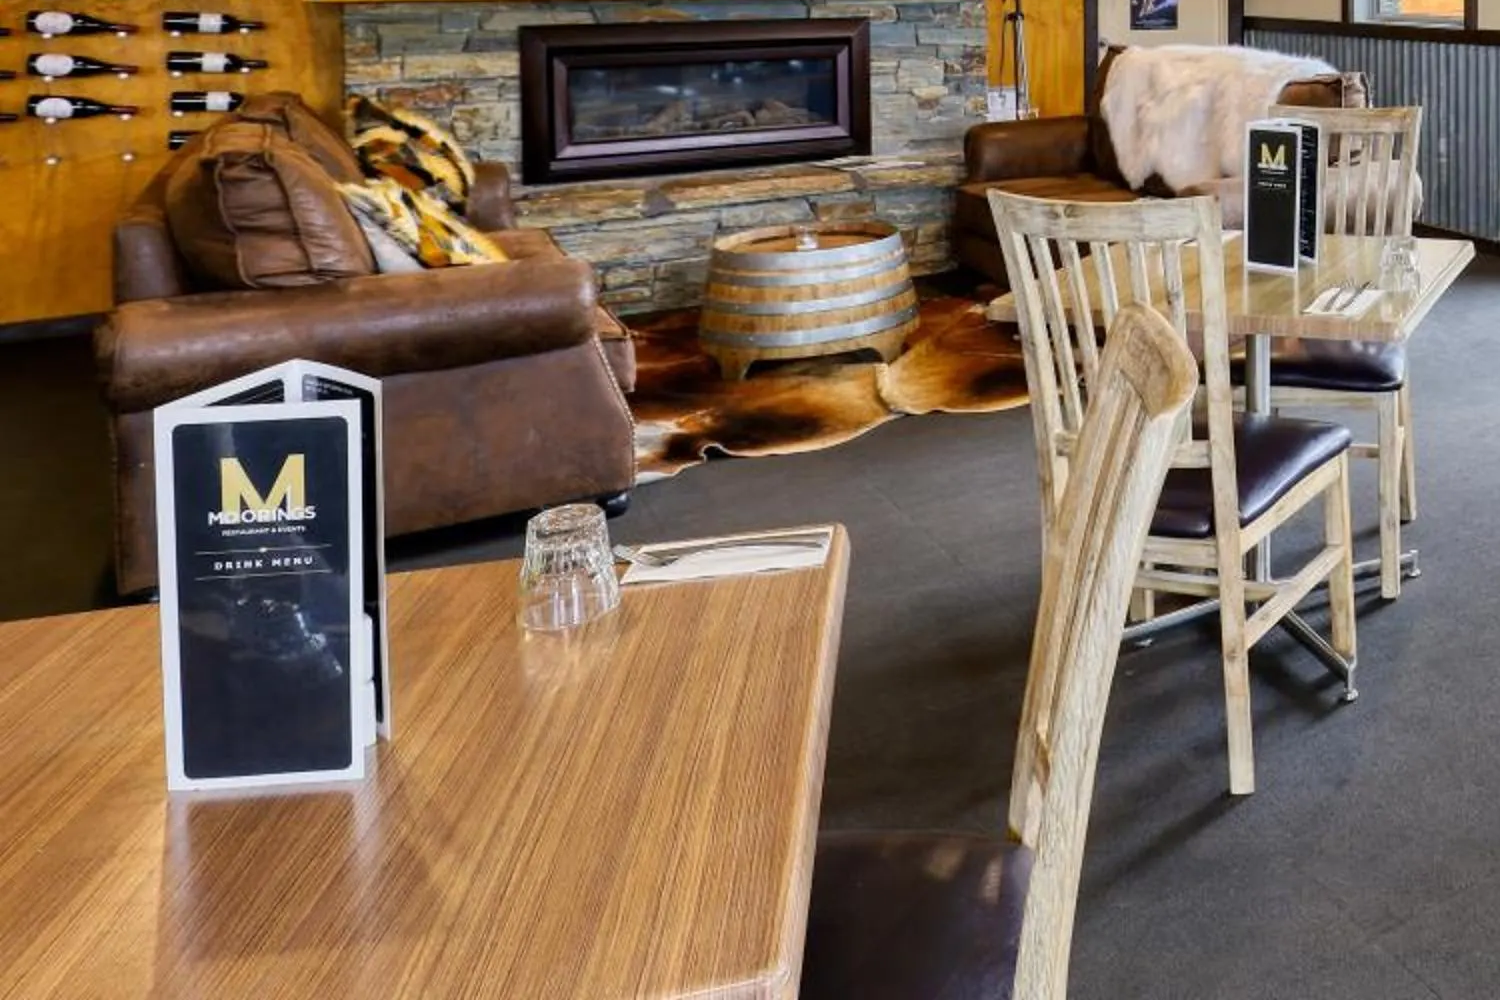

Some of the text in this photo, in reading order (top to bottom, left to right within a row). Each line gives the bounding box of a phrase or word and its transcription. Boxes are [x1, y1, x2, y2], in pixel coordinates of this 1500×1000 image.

[220, 454, 305, 523] M
[207, 505, 317, 526] MOORINGS
[213, 556, 313, 571] DRINK MENU
